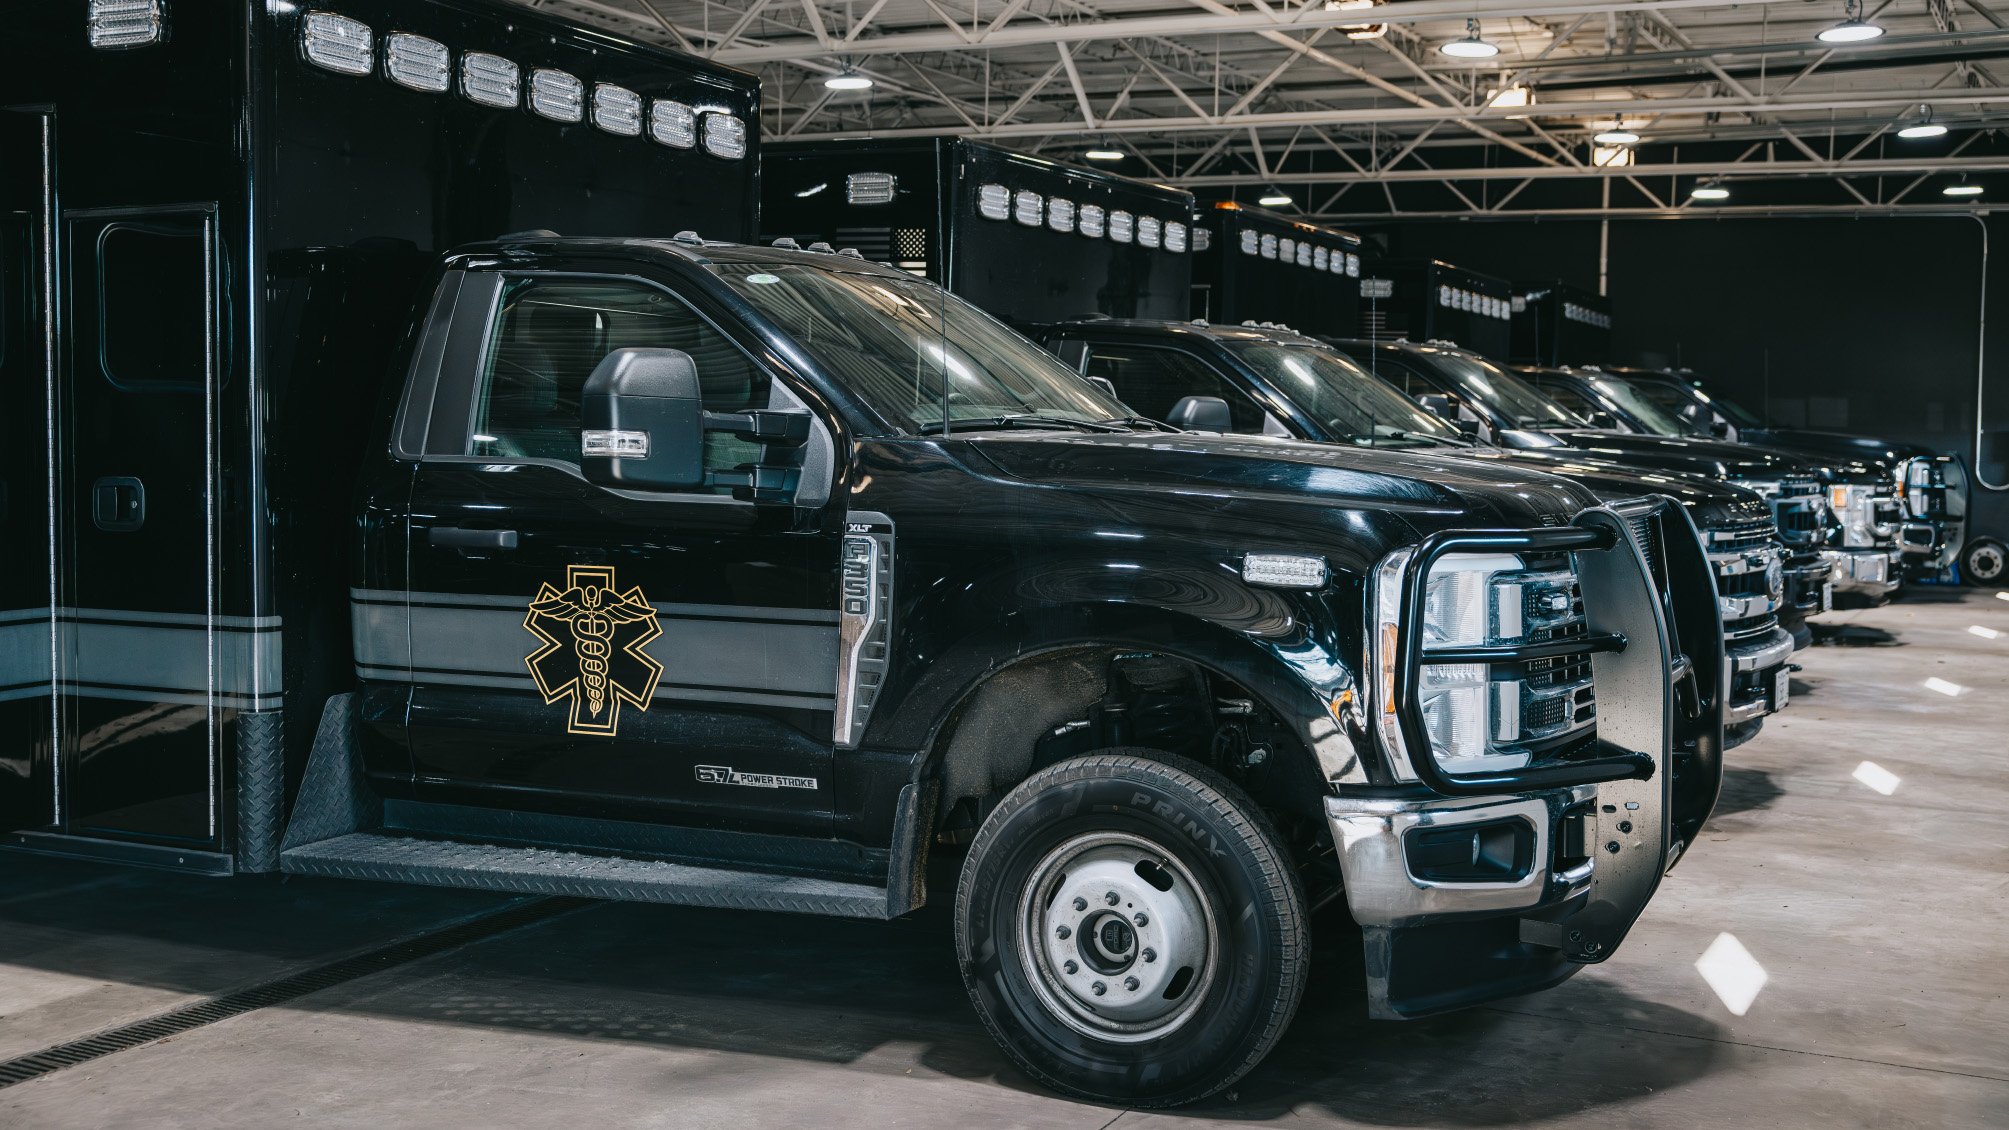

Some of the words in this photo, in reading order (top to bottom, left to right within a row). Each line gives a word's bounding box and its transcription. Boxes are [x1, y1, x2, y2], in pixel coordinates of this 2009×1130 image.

[848, 523, 872, 532] XLT
[740, 774, 774, 785] POWER
[775, 776, 815, 788] STROKE
[1130, 792, 1227, 858] PRINX
